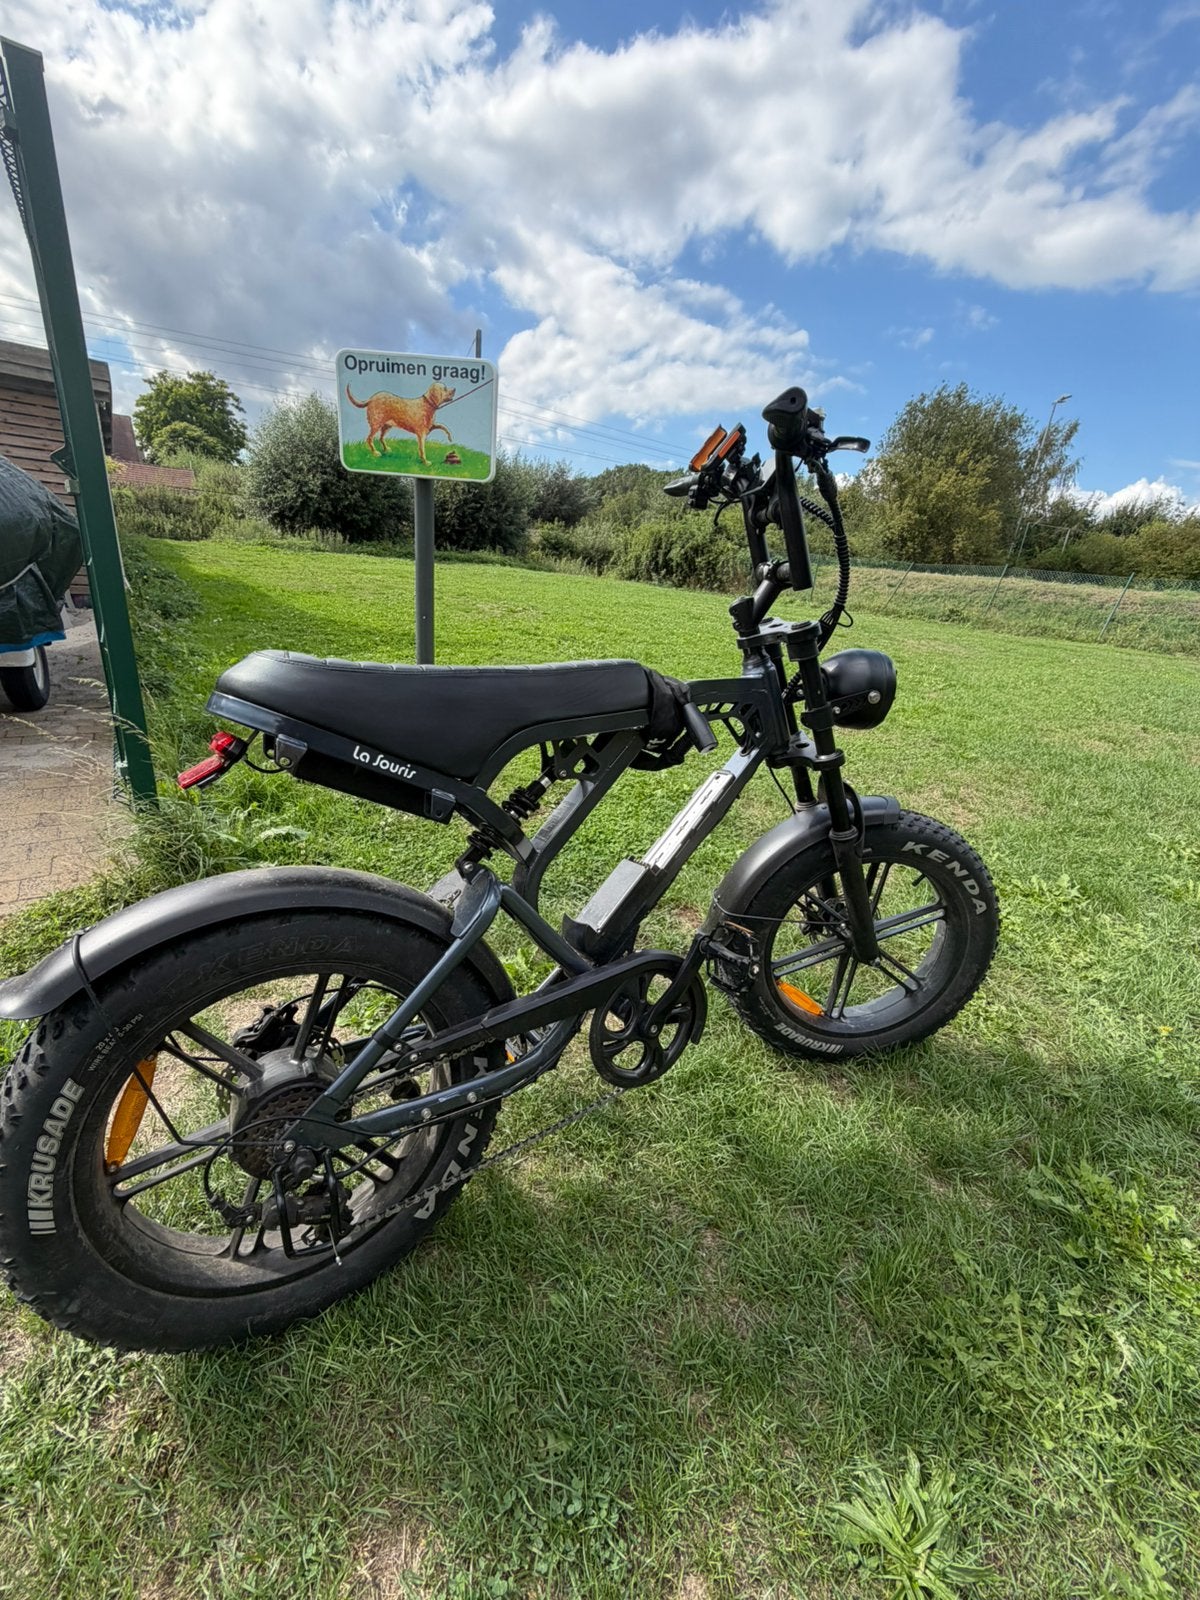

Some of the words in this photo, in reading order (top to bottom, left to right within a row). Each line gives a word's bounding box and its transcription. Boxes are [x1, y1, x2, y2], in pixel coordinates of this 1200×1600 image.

[344, 354, 427, 376] Opruimen
[432, 364, 486, 384] graag!
[353, 745, 371, 763] La
[372, 754, 417, 778] Souris
[900, 841, 987, 915] KENDA
[774, 1022, 830, 1053] KRUSADE
[88, 1054, 105, 1071] WIRE
[27, 1077, 86, 1208] KRUSADE
[413, 1056, 489, 1220] KNDA
